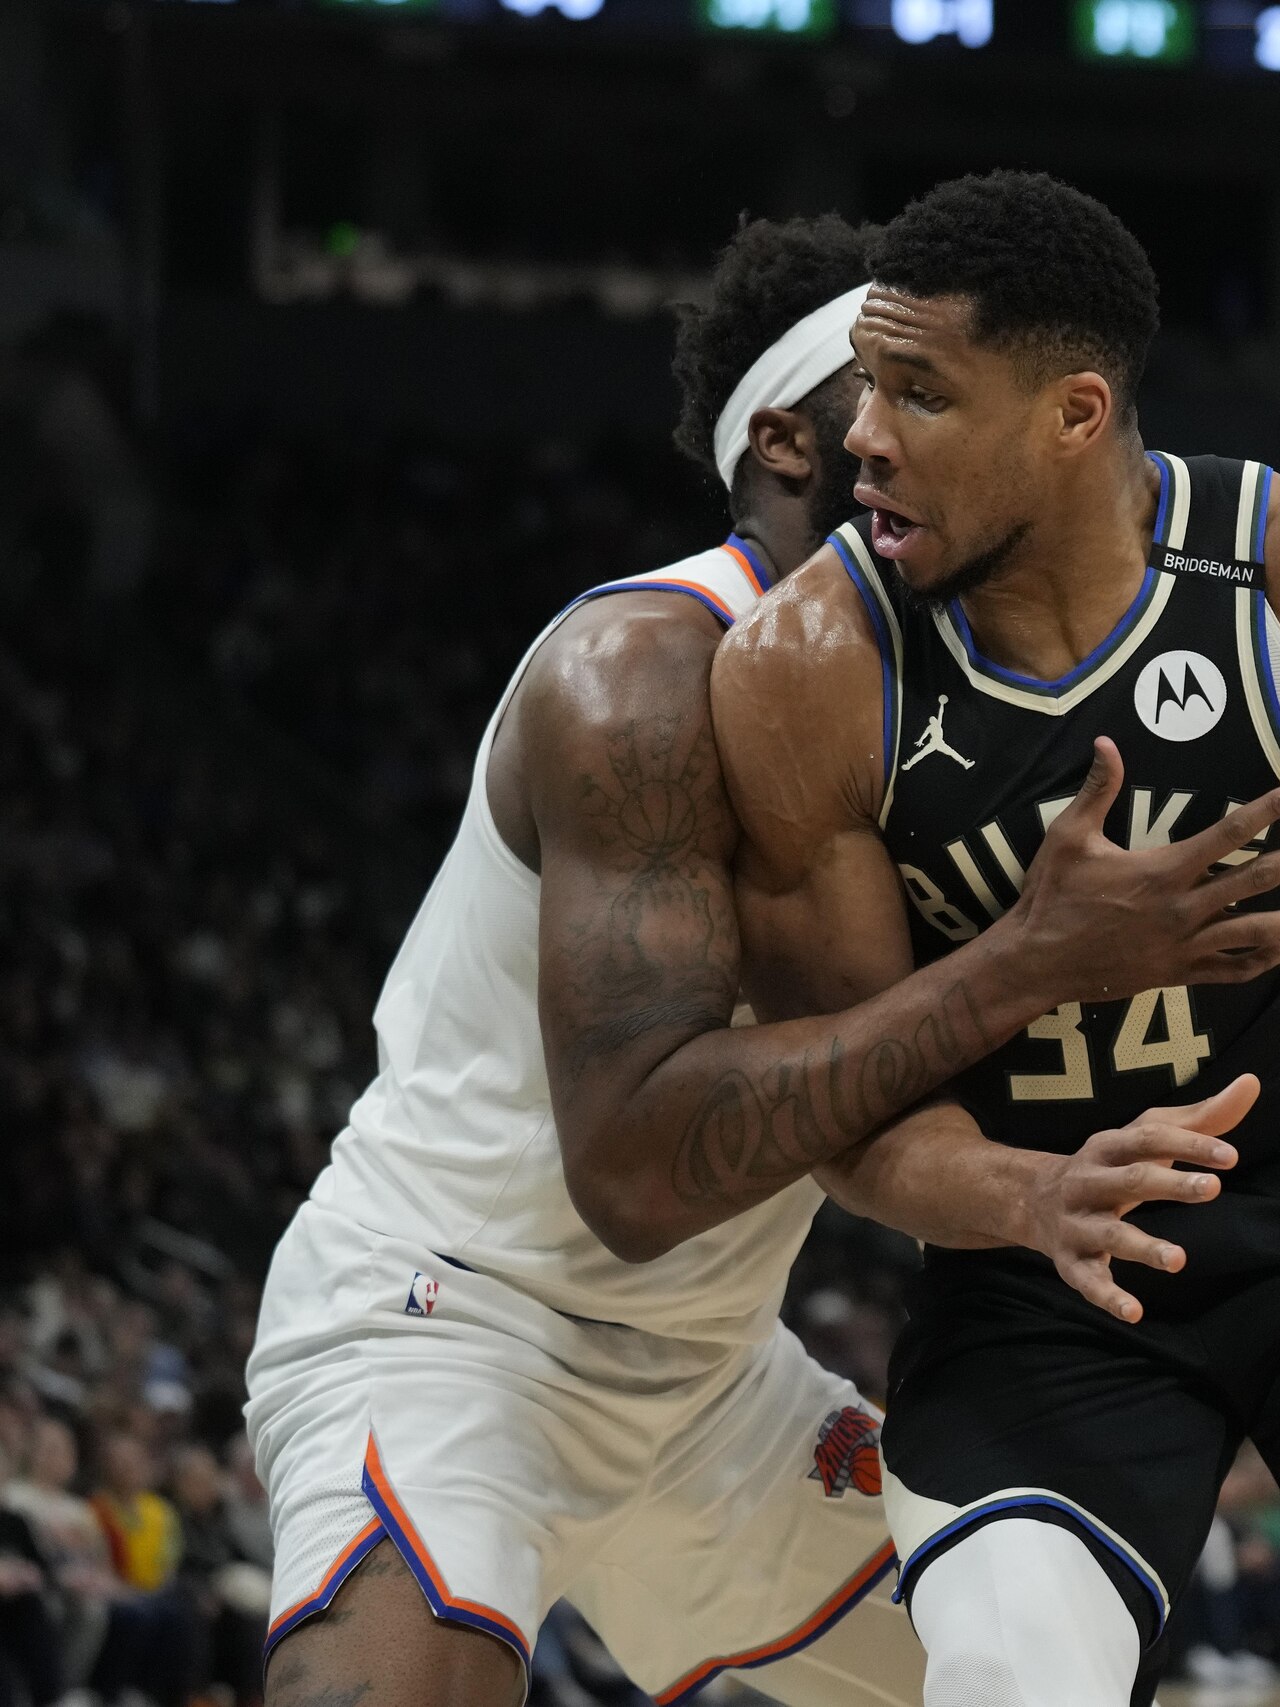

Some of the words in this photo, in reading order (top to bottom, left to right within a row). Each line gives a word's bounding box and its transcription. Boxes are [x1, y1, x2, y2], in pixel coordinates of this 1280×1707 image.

[1163, 552, 1254, 583] BRIDGEMAN
[1009, 984, 1212, 1101] 34
[814, 1405, 880, 1497] KNICKS
